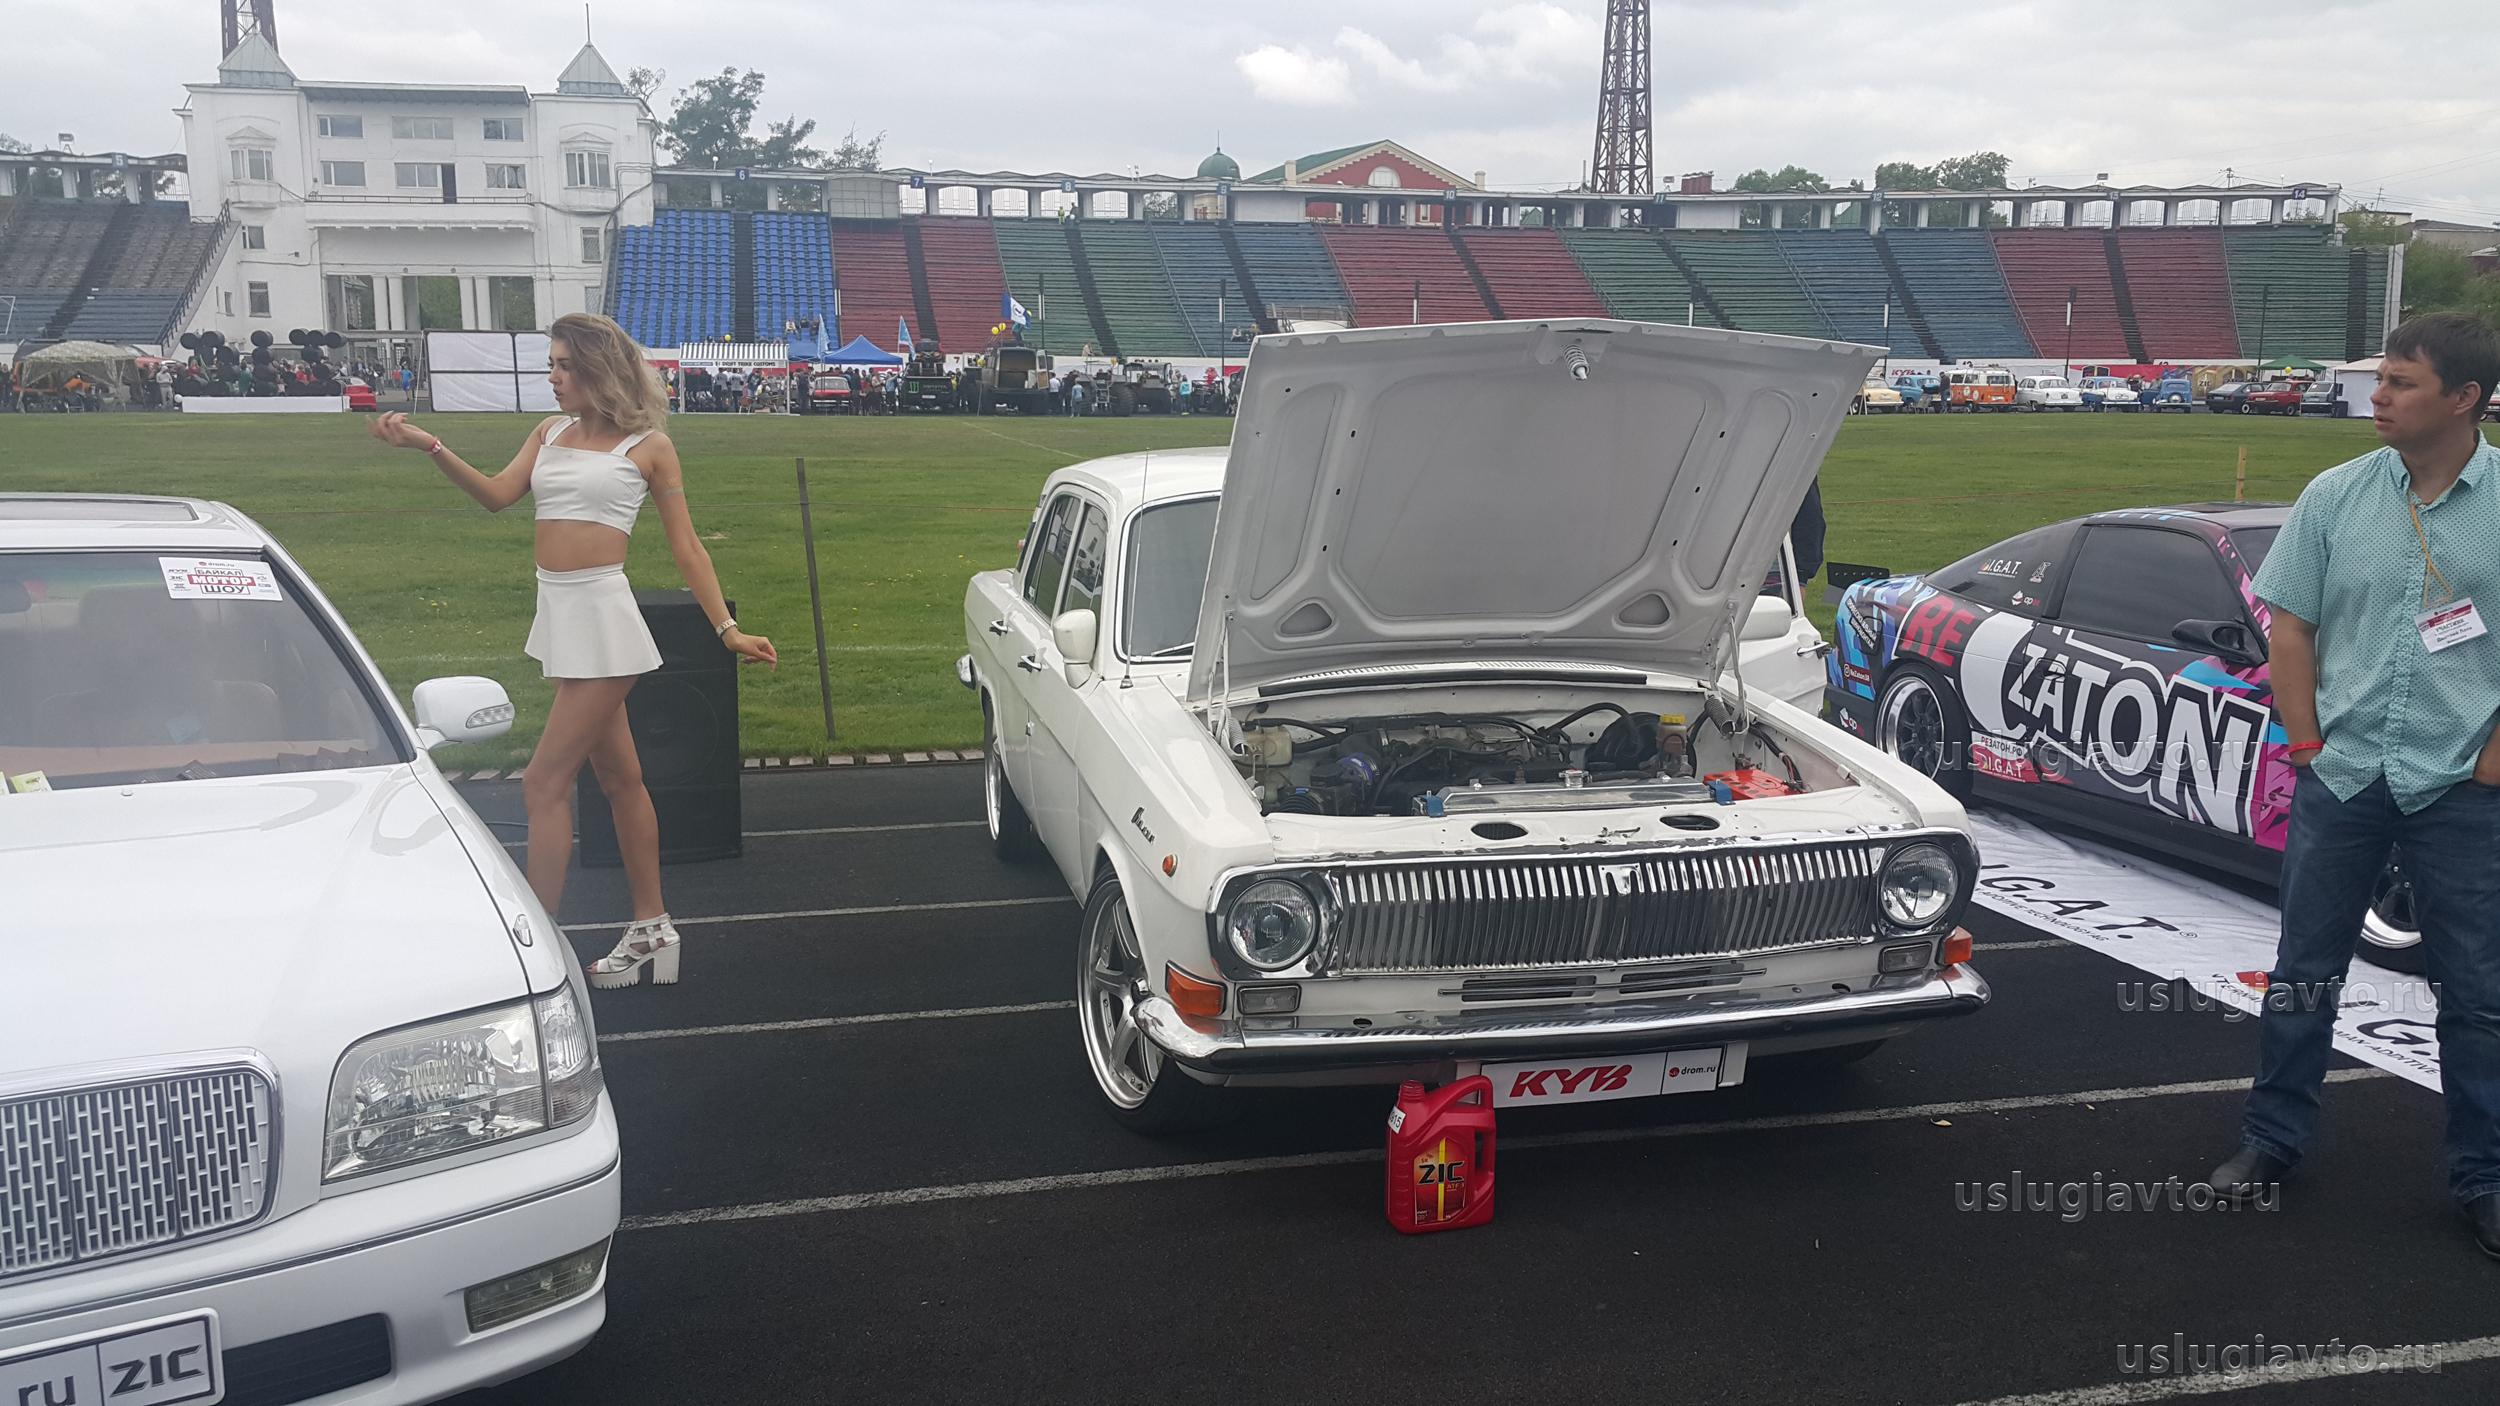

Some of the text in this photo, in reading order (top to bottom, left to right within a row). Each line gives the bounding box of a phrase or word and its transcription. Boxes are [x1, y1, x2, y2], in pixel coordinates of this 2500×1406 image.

[115, 154, 124, 166] 5
[739, 171, 746, 181] 6
[913, 177, 921, 187] 7
[1064, 181, 1072, 191] 8
[1220, 184, 1227, 194] 9
[2294, 189, 2306, 199] 14
[1446, 190, 1455, 199] 10
[1655, 193, 1665, 203] 11
[1872, 191, 1883, 201] 12
[952, 356, 961, 364] 7
[197, 568, 242, 576] БАЙКАЛ
[191, 575, 253, 585] МОТОР
[204, 585, 245, 594] ШОУ
[2008, 641, 2252, 835] ZATON
[1981, 736, 2023, 757] РЕЗАТОН.РФ
[2365, 1044, 2441, 1075] ADDITIVE
[1680, 1064, 1717, 1076] drom.ru
[1509, 1064, 1633, 1098] KYB
[1418, 1161, 1465, 1186] ZIC
[109, 1344, 205, 1398] ZIC
